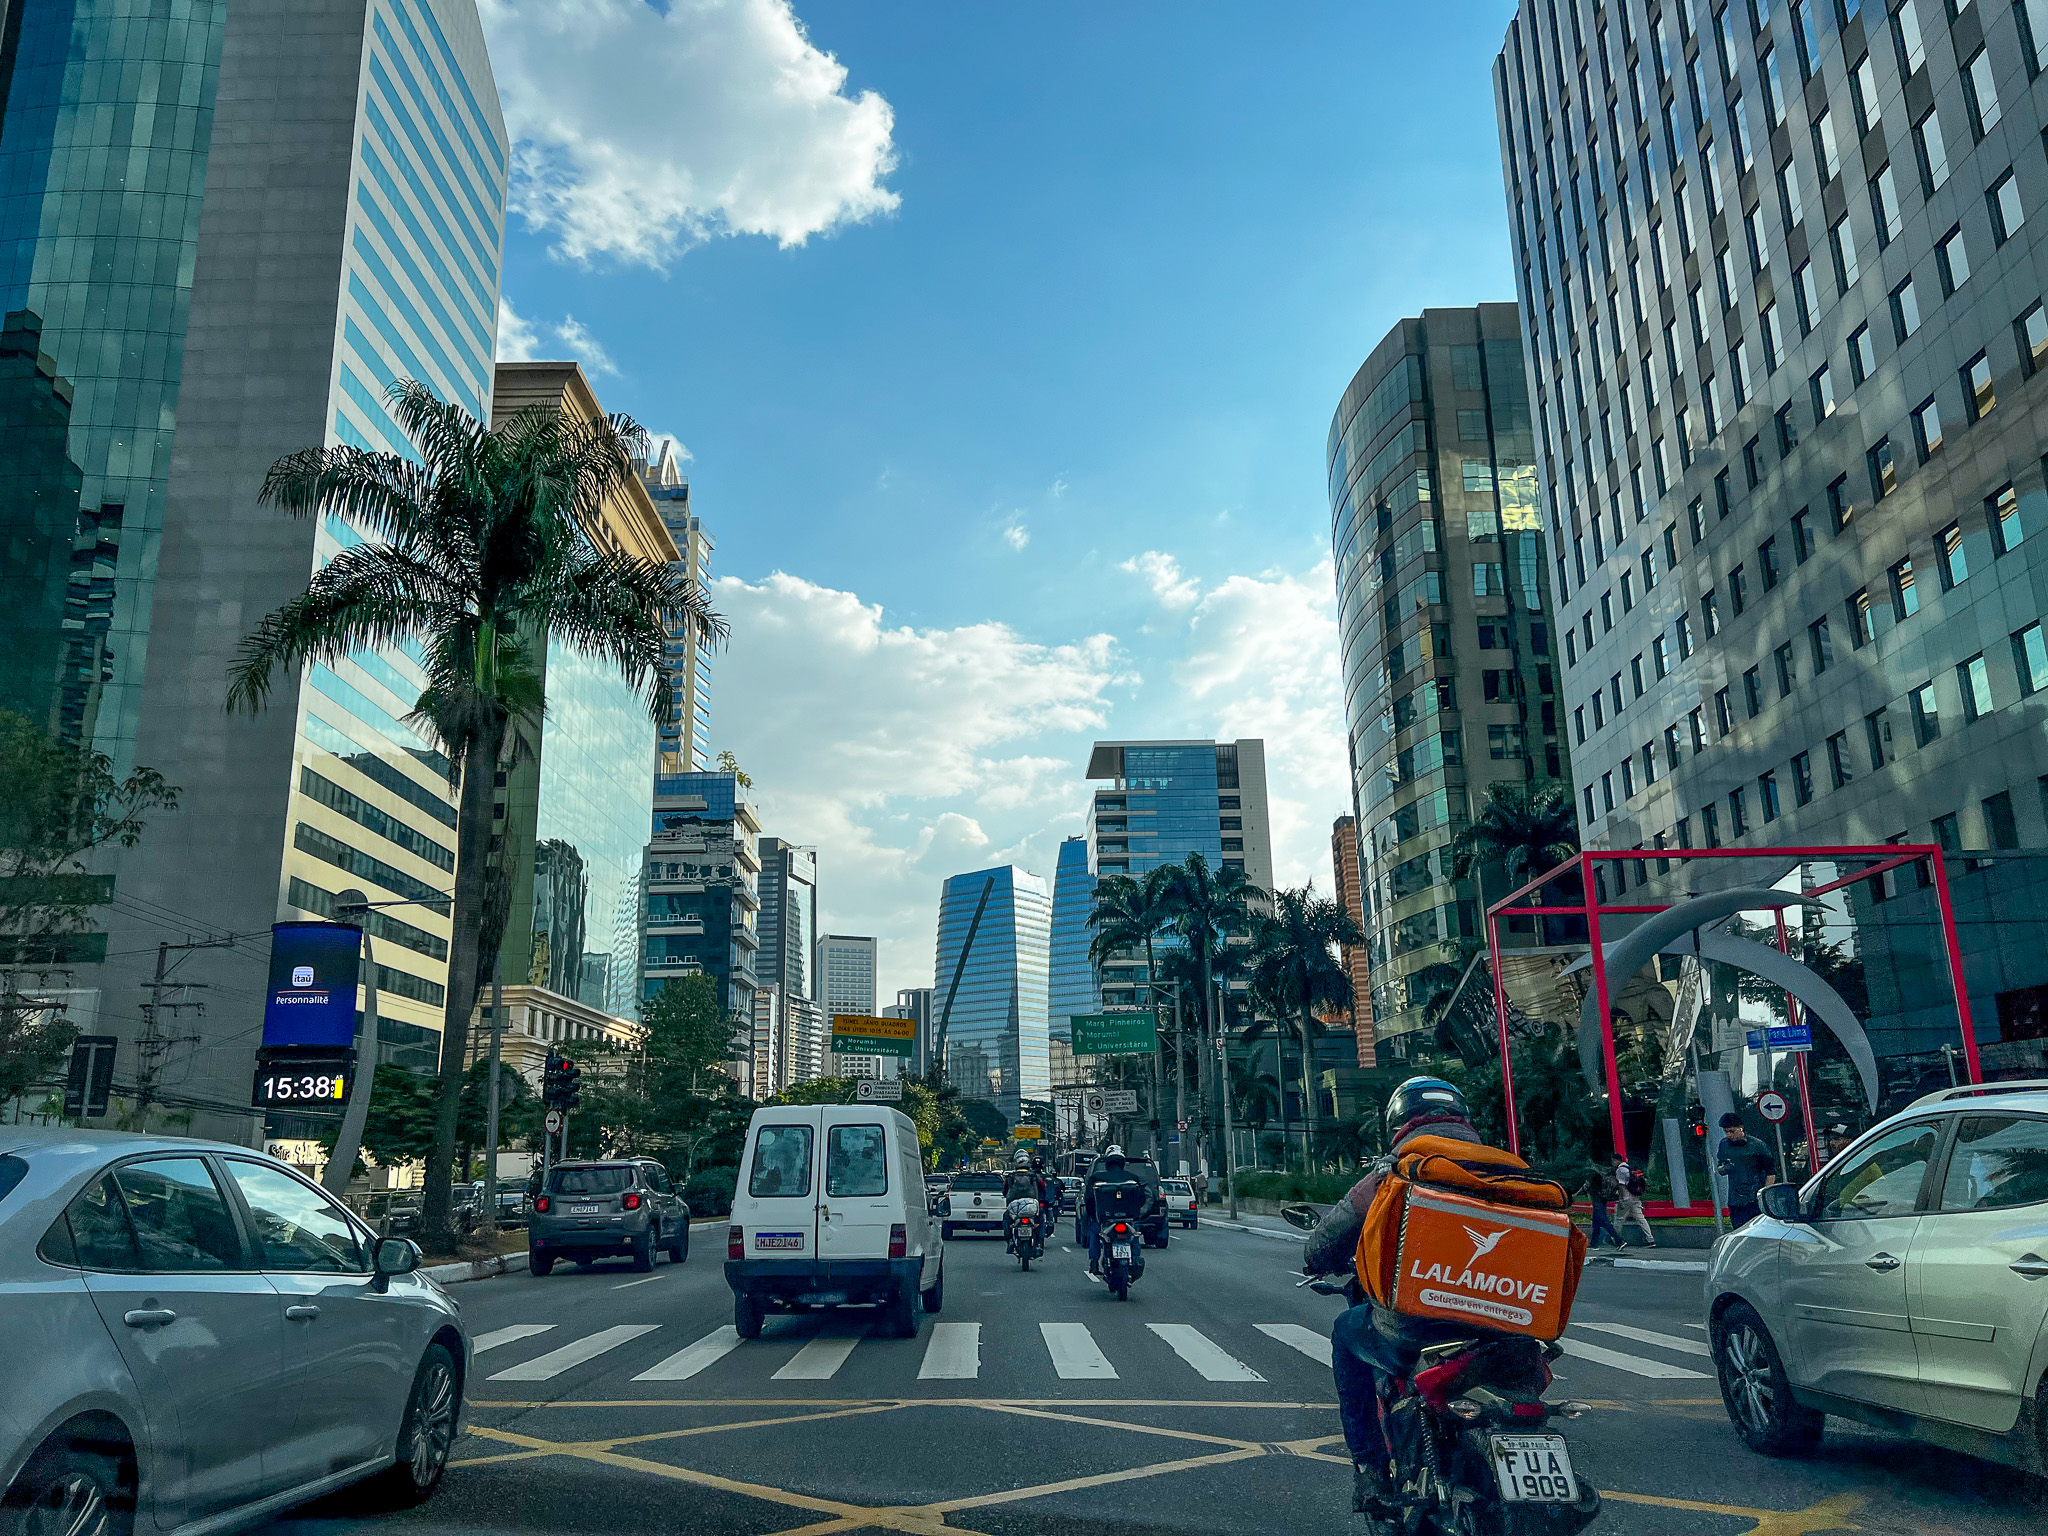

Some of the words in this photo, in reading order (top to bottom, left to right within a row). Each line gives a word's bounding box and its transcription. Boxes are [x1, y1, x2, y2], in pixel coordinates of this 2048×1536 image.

[294, 975, 311, 983] itaú
[276, 996, 329, 1005] Personnalité
[1086, 1020, 1105, 1028] Marg
[855, 1045, 899, 1054] Universitária
[1097, 1040, 1148, 1050] Universitária
[264, 1076, 330, 1099] 15:38
[1696, 1125, 1703, 1136] 6
[1410, 1259, 1549, 1304] LALAMOVE
[1484, 1306, 1523, 1319] entregas
[1505, 1451, 1562, 1474] FUA
[1511, 1475, 1570, 1498] 1909
